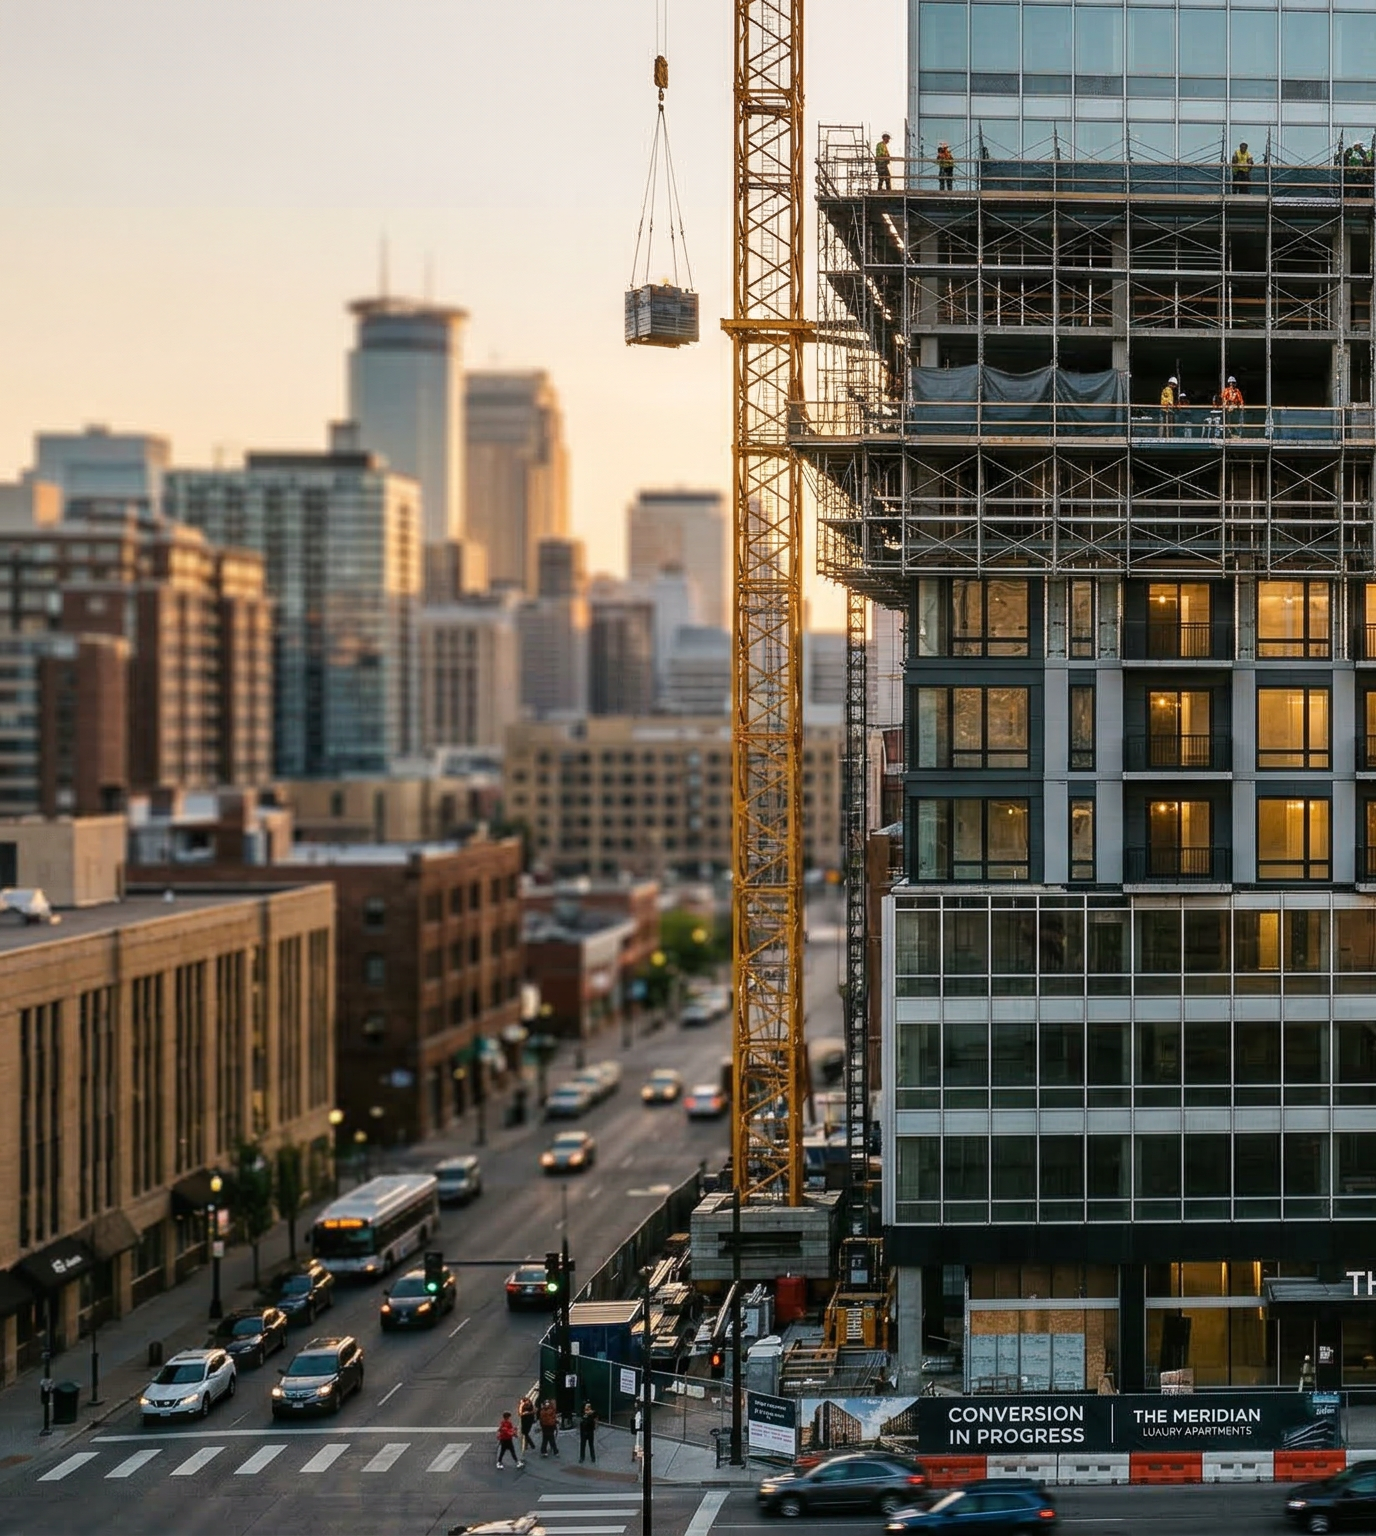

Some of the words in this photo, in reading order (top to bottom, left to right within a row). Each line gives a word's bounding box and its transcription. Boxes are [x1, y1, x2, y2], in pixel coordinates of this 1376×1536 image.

[948, 1405, 1084, 1423] CONVERSION
[1133, 1409, 1168, 1424] THE
[1173, 1408, 1261, 1423] MERIDIAN
[949, 1429, 970, 1445] IN
[977, 1427, 1085, 1445] PROGRESS
[1184, 1426, 1252, 1436] APARTMENTS
